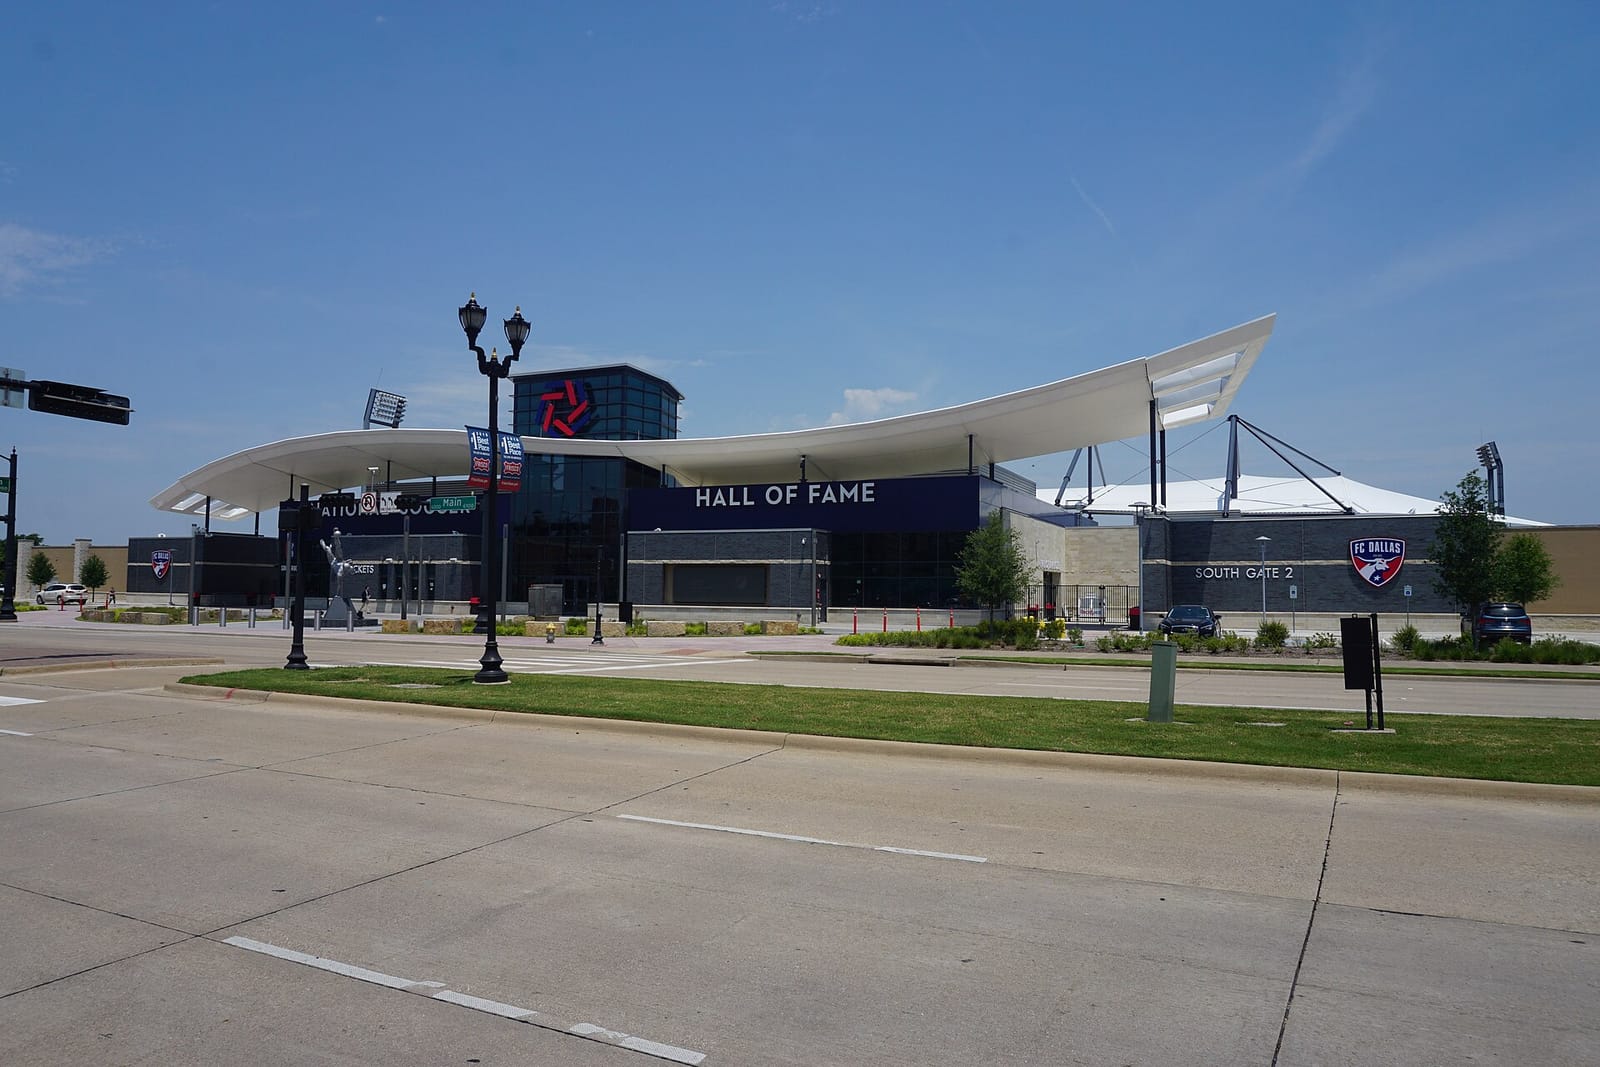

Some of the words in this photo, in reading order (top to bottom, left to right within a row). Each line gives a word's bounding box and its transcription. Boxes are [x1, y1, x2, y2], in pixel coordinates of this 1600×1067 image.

[695, 487, 755, 507] HALL
[765, 485, 798, 505] OF
[808, 483, 875, 504] FAME
[442, 497, 462, 507] Main
[1354, 542, 1365, 554] FC
[1368, 541, 1401, 554] DALLAS
[1195, 567, 1240, 579] SOUTH
[1246, 567, 1280, 579] GATE
[1285, 567, 1294, 579] 2
